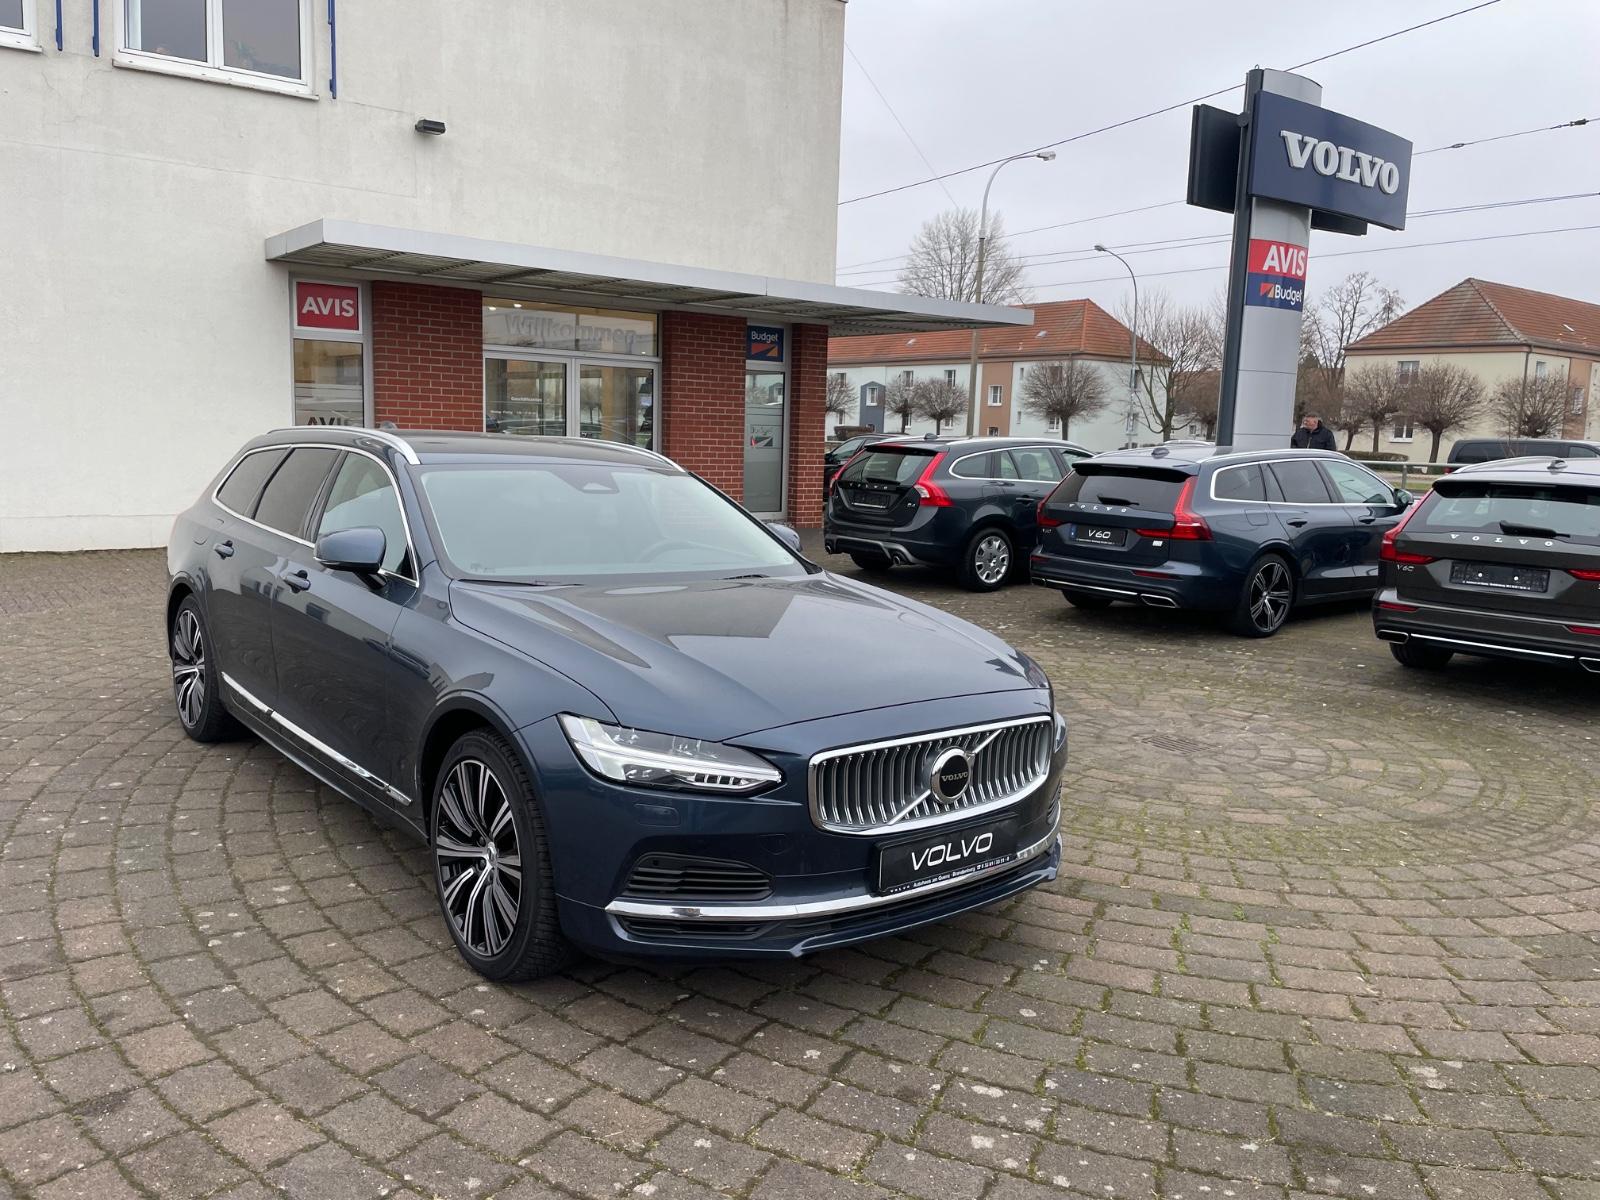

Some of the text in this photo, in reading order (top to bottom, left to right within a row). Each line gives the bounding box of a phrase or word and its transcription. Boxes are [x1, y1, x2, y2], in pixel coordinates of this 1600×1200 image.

[1280, 130, 1399, 195] VOLVO
[1262, 244, 1305, 277] AVIS
[1274, 284, 1302, 306] Budget
[301, 296, 355, 318] AVIS
[504, 314, 636, 344] Willkommen
[751, 330, 778, 344] Budget
[1069, 503, 1127, 512] VOLVO
[1088, 529, 1111, 539] V60
[1450, 534, 1552, 546] VOLVO
[941, 771, 968, 782] VOLVO
[911, 832, 993, 871] VOLVO
